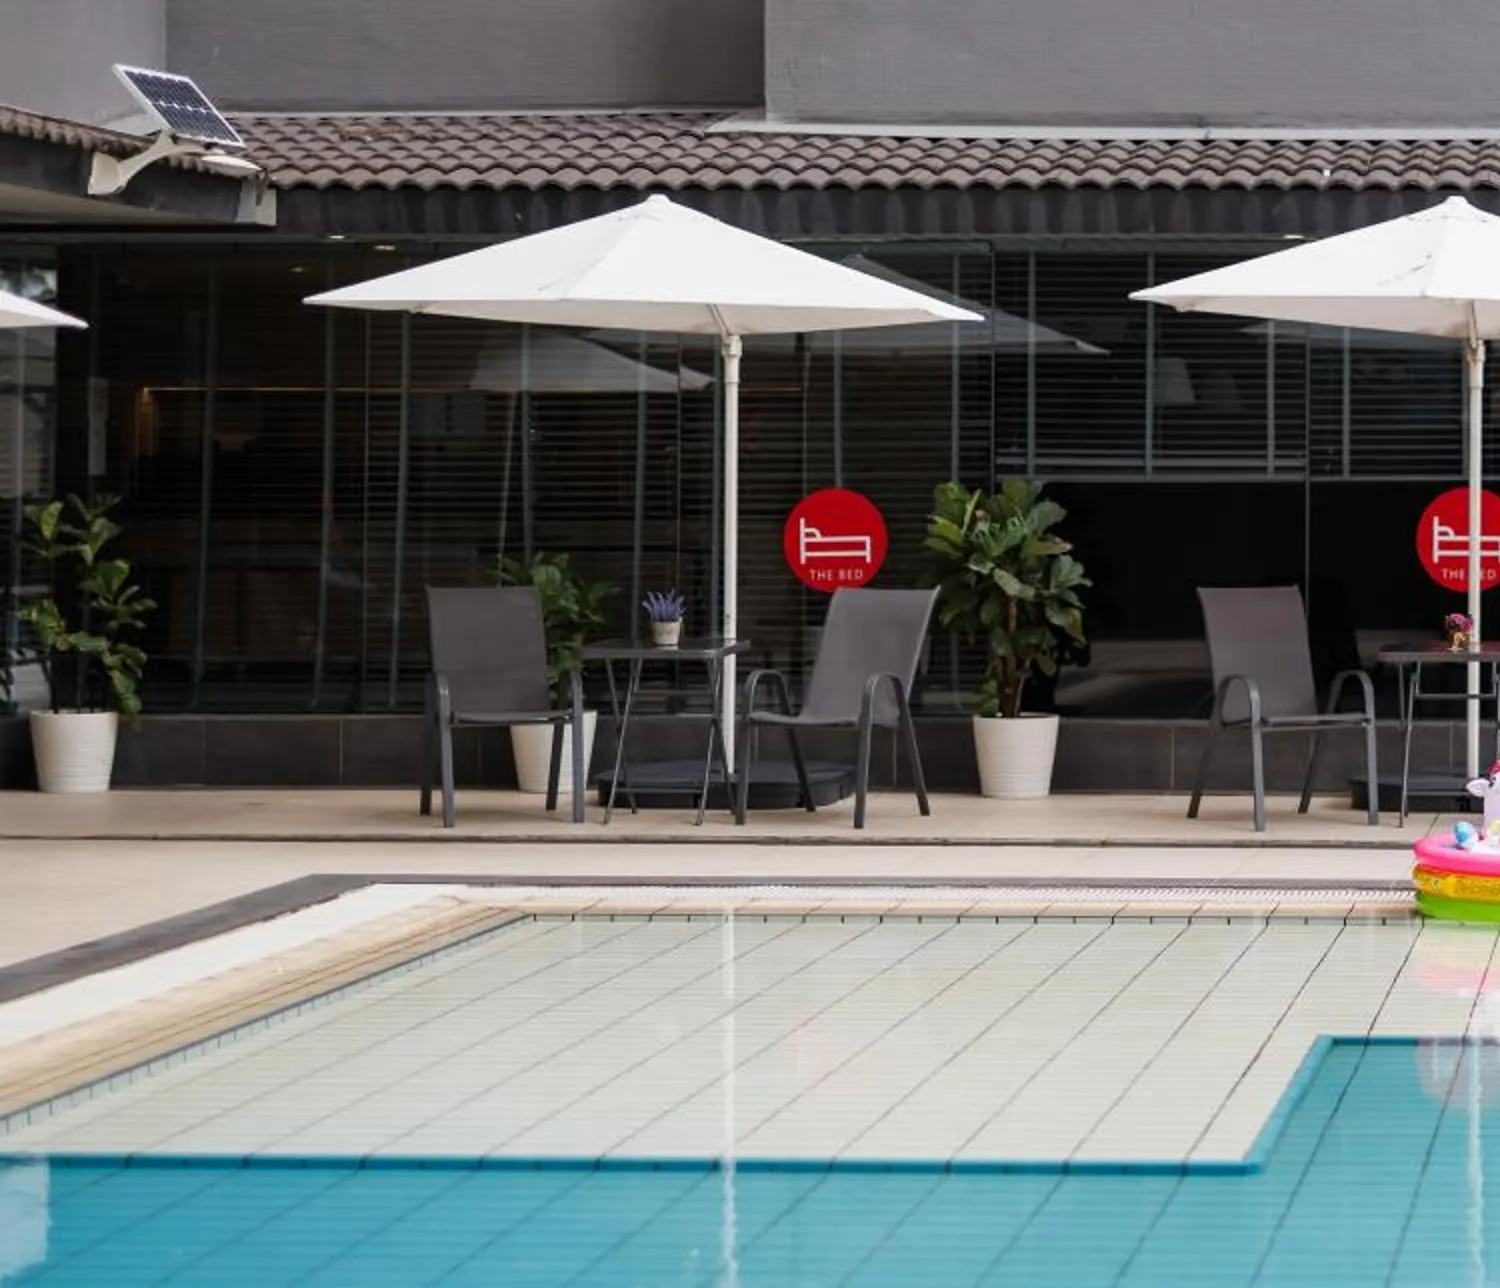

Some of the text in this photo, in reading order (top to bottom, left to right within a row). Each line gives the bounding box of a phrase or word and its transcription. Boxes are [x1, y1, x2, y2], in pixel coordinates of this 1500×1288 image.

[809, 568, 863, 580] THE BED
[1441, 568, 1465, 580] THE
